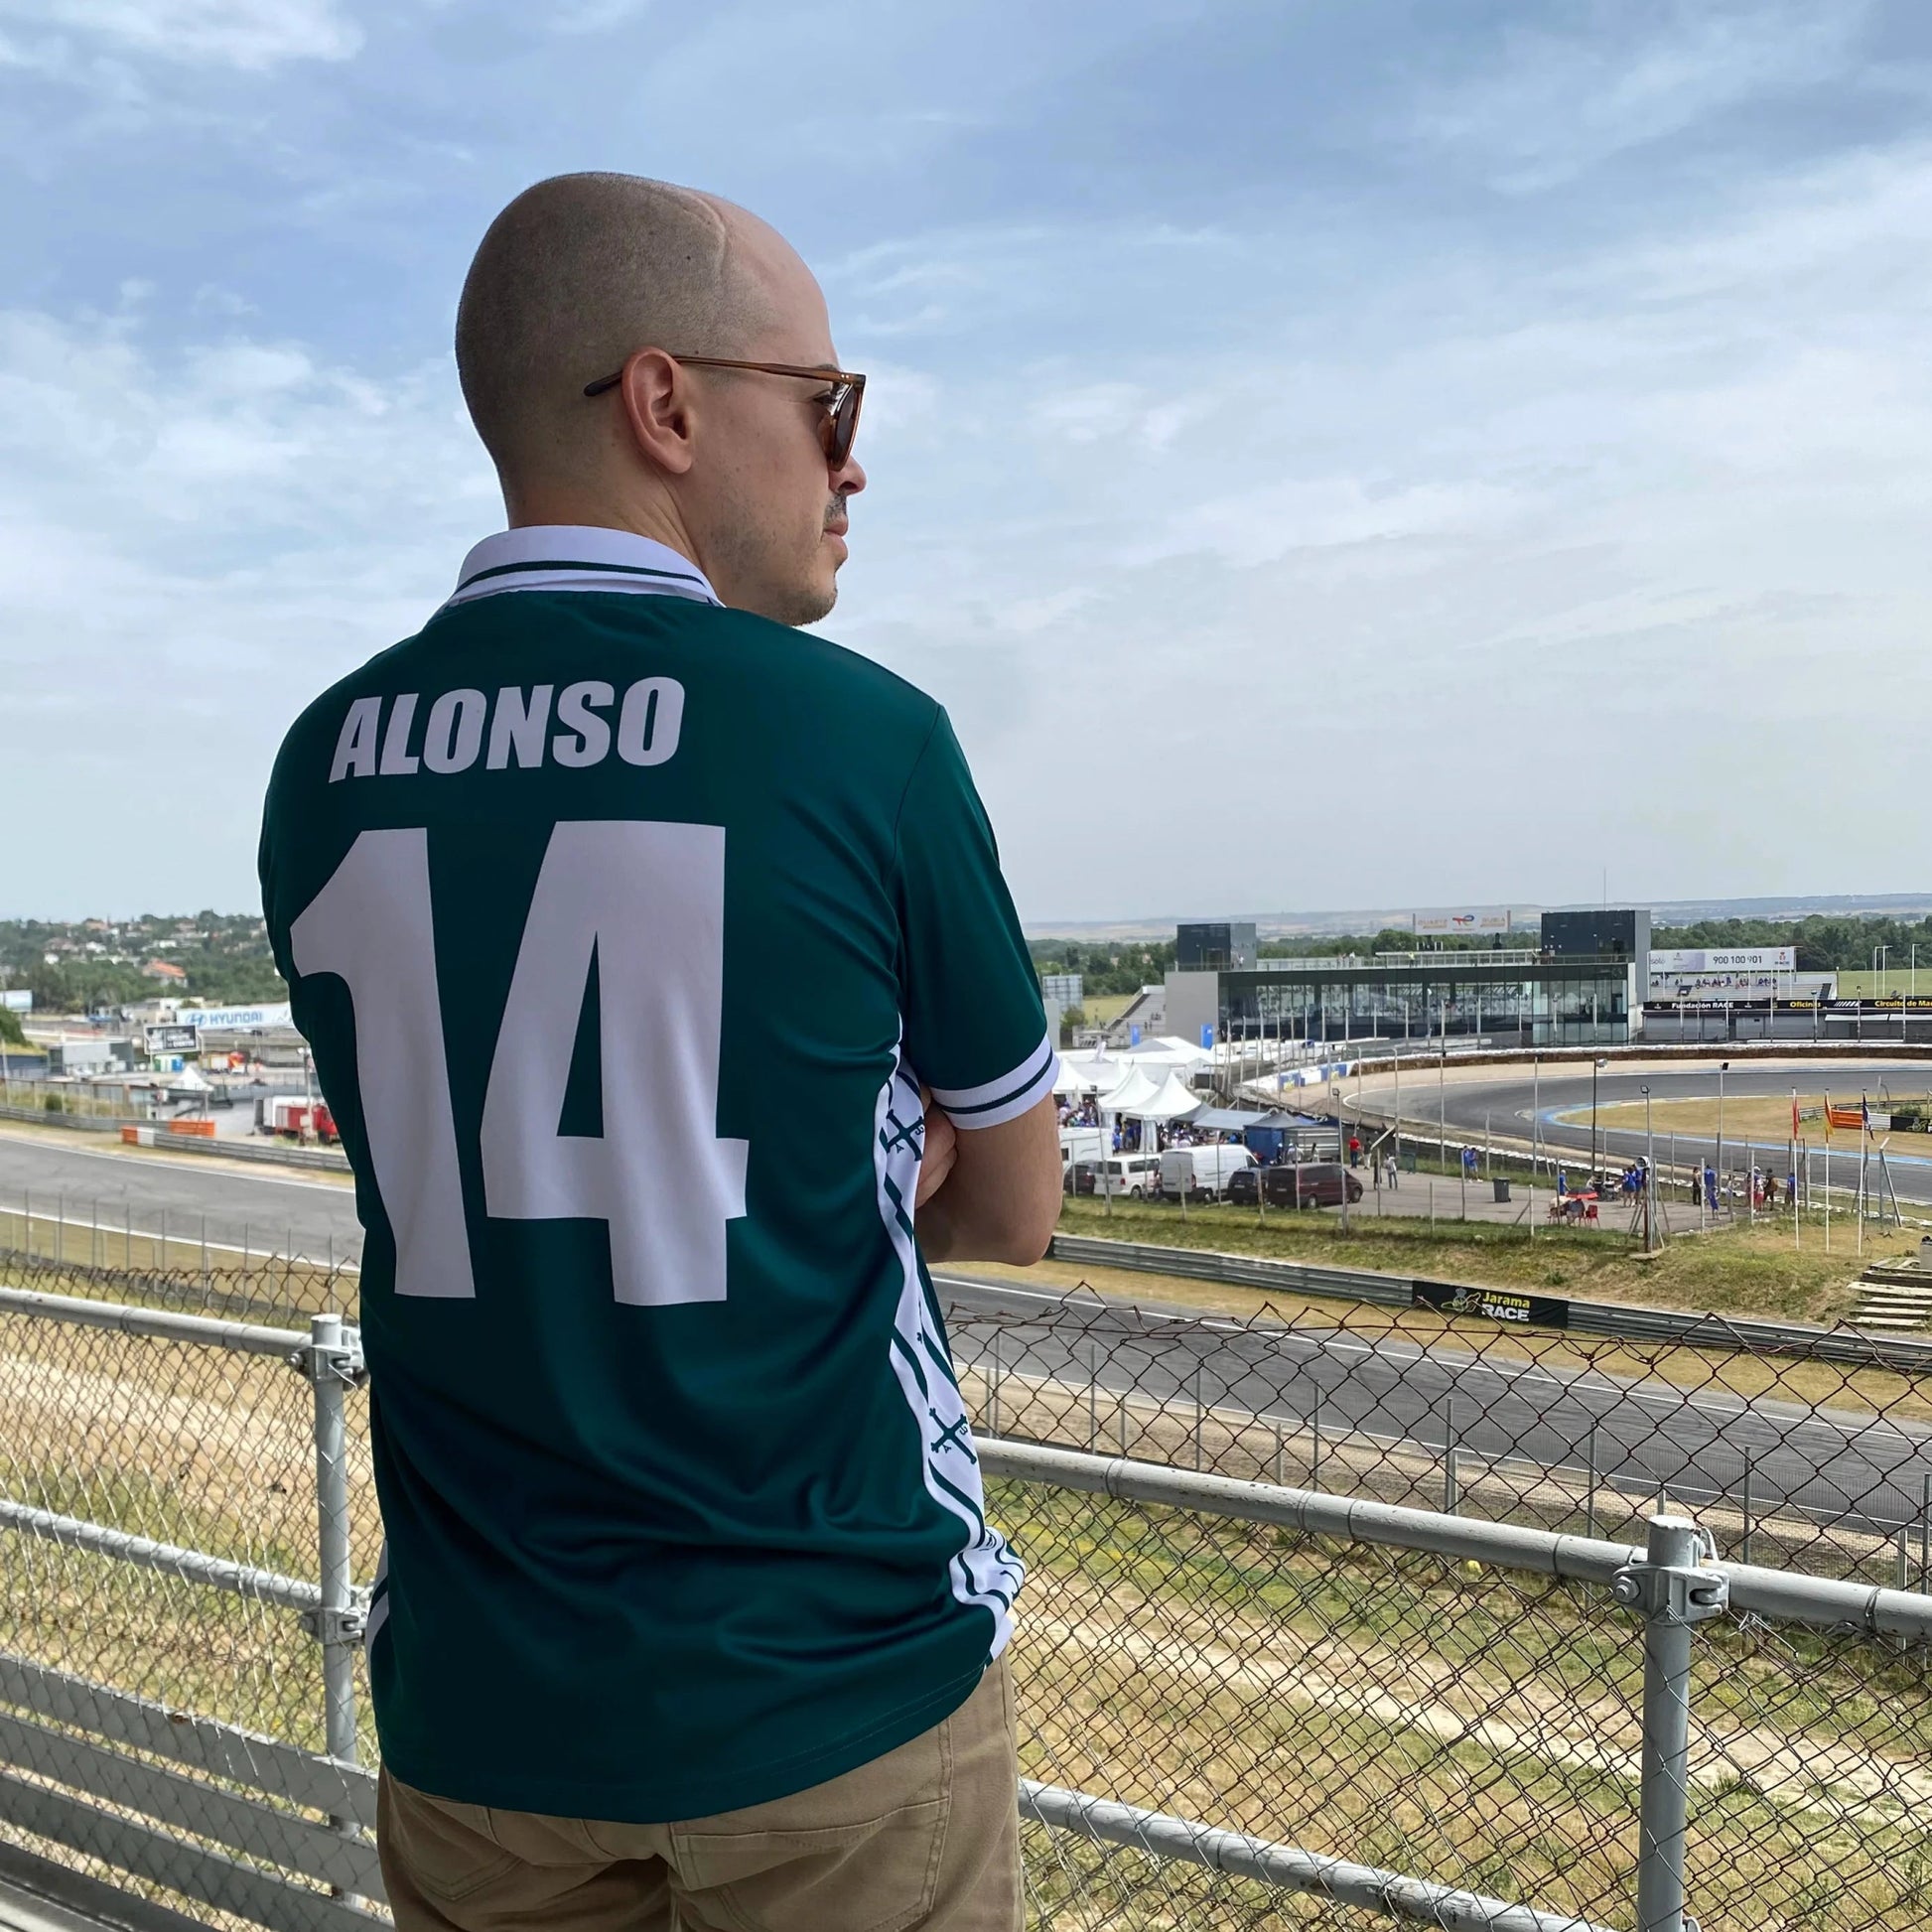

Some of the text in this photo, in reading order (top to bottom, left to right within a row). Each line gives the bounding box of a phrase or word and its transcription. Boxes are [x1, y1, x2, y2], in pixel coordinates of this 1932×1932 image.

[329, 676, 686, 783] ALONSO
[1747, 955, 1762, 964] 901
[209, 1012, 262, 1025] HYUNDAI
[290, 820, 750, 1307] 14
[1482, 1292, 1531, 1309] Jarama
[1481, 1304, 1530, 1321] RACE
